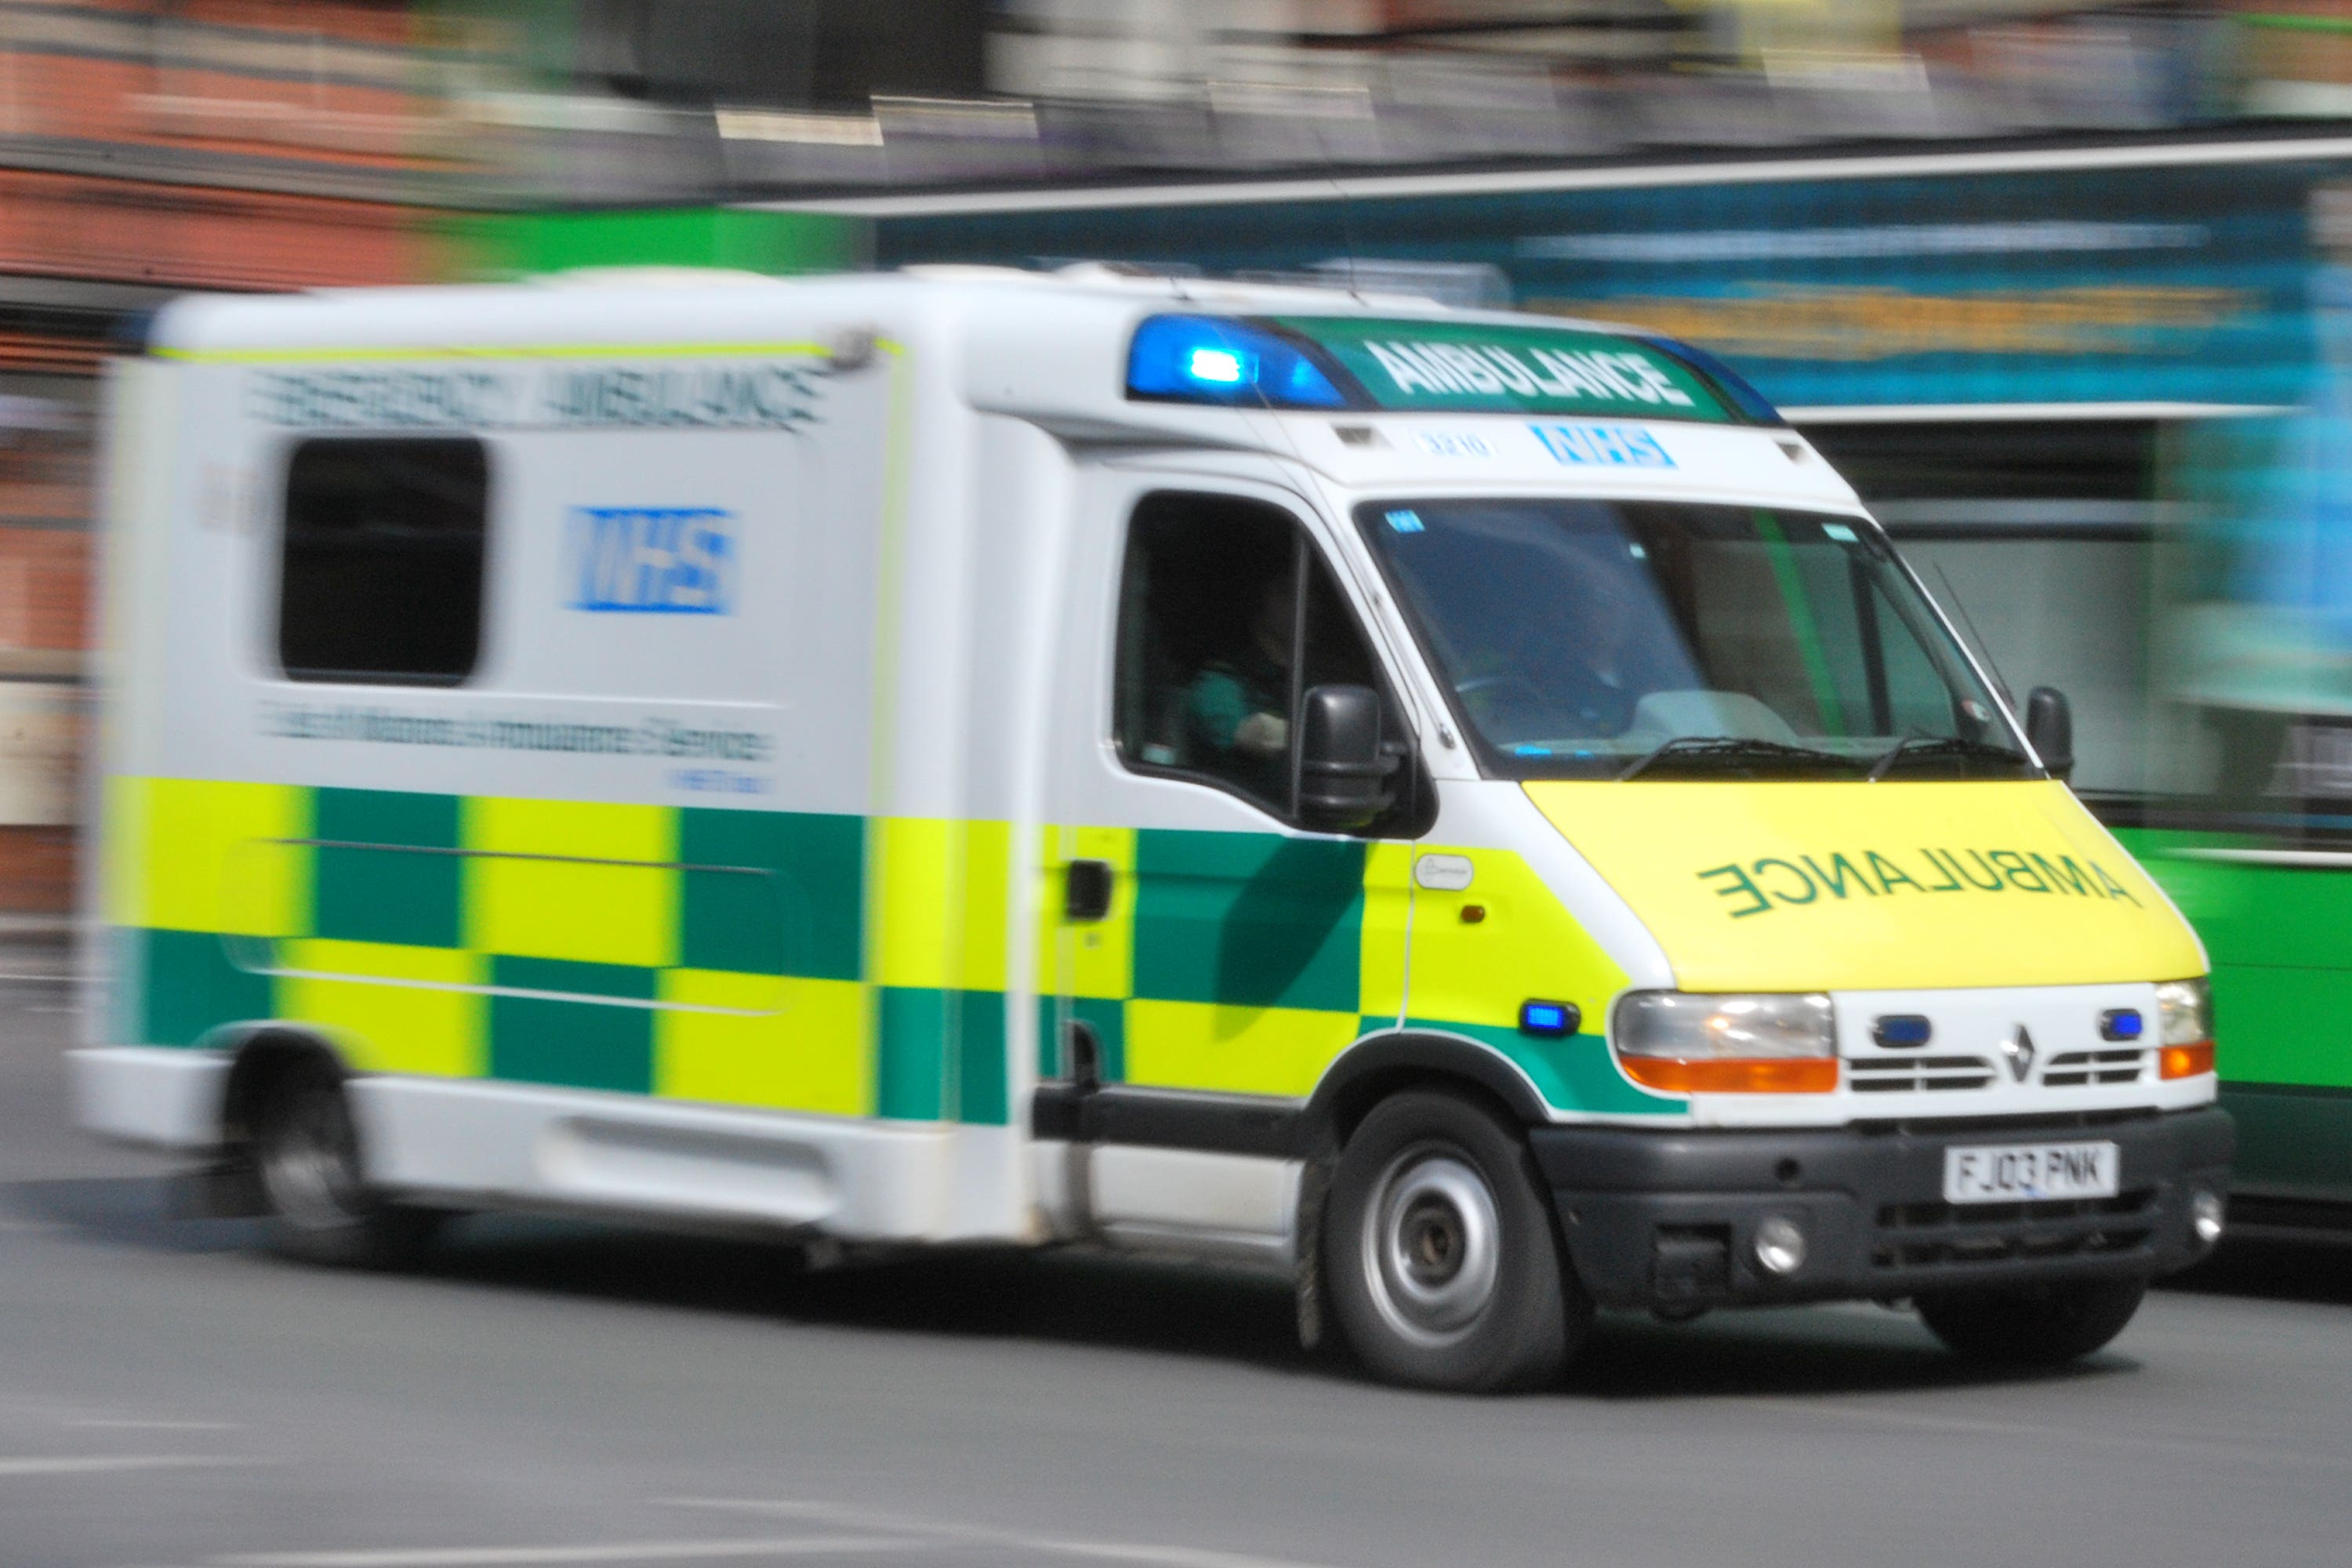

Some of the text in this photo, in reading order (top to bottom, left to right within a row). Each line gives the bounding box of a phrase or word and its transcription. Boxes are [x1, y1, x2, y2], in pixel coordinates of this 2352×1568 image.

[1363, 339, 1697, 407] AMBULANCE
[1534, 423, 1675, 468] NHS
[572, 510, 732, 612] NHS
[1958, 1149, 2100, 1191] FJ03 PNK
